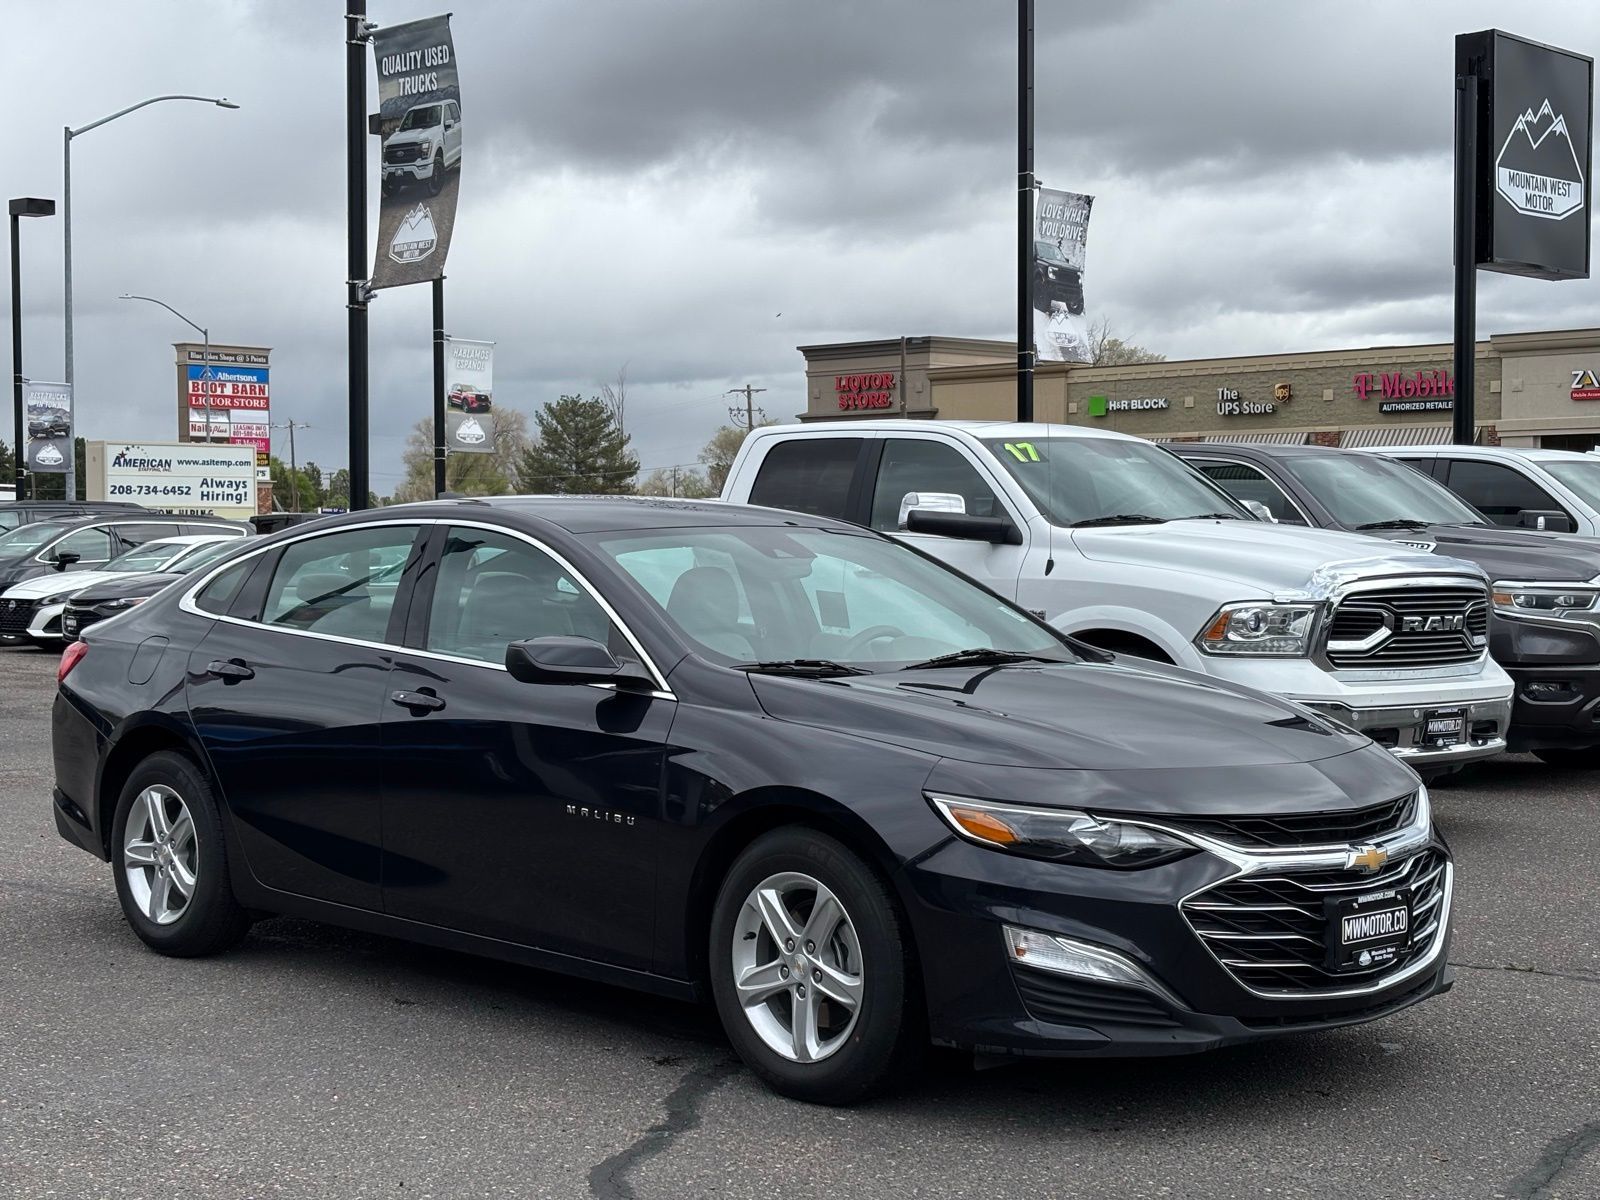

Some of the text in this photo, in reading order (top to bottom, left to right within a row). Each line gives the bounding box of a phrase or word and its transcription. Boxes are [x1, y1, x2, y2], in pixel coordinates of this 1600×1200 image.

[382, 45, 450, 76] QUALITY USED
[399, 72, 438, 96] TRUCKS
[1508, 170, 1571, 198] MOUNTAIN WEST
[1525, 192, 1554, 212] MOTOR
[1041, 202, 1086, 224] LOVE WHAT
[1041, 220, 1083, 241] YOU DRIVE
[236, 355, 245, 363] @
[251, 355, 266, 363] Points
[453, 348, 489, 360] HABLAMOS
[457, 359, 485, 370] ESPAÑOL
[217, 371, 258, 382] Albertsons
[835, 372, 896, 393] LIQUOR
[231, 383, 266, 396] BARN
[1217, 387, 1240, 401] The
[234, 399, 267, 408] STORE
[838, 392, 892, 410] STORE
[1109, 398, 1167, 410] H&R BLOCK
[1216, 401, 1273, 415] UPS Store
[1382, 401, 1453, 412] AUTHORIZED RETAILE
[1004, 442, 1040, 462] 17
[112, 455, 252, 469] AMERICAN www.asitemp.com
[109, 478, 248, 496] 208-734-6452 Always
[200, 491, 248, 505] Hiring!
[1402, 615, 1463, 631] RAM
[566, 804, 635, 826] MALIBU
[1343, 910, 1406, 941] MWMOTOR.CO
